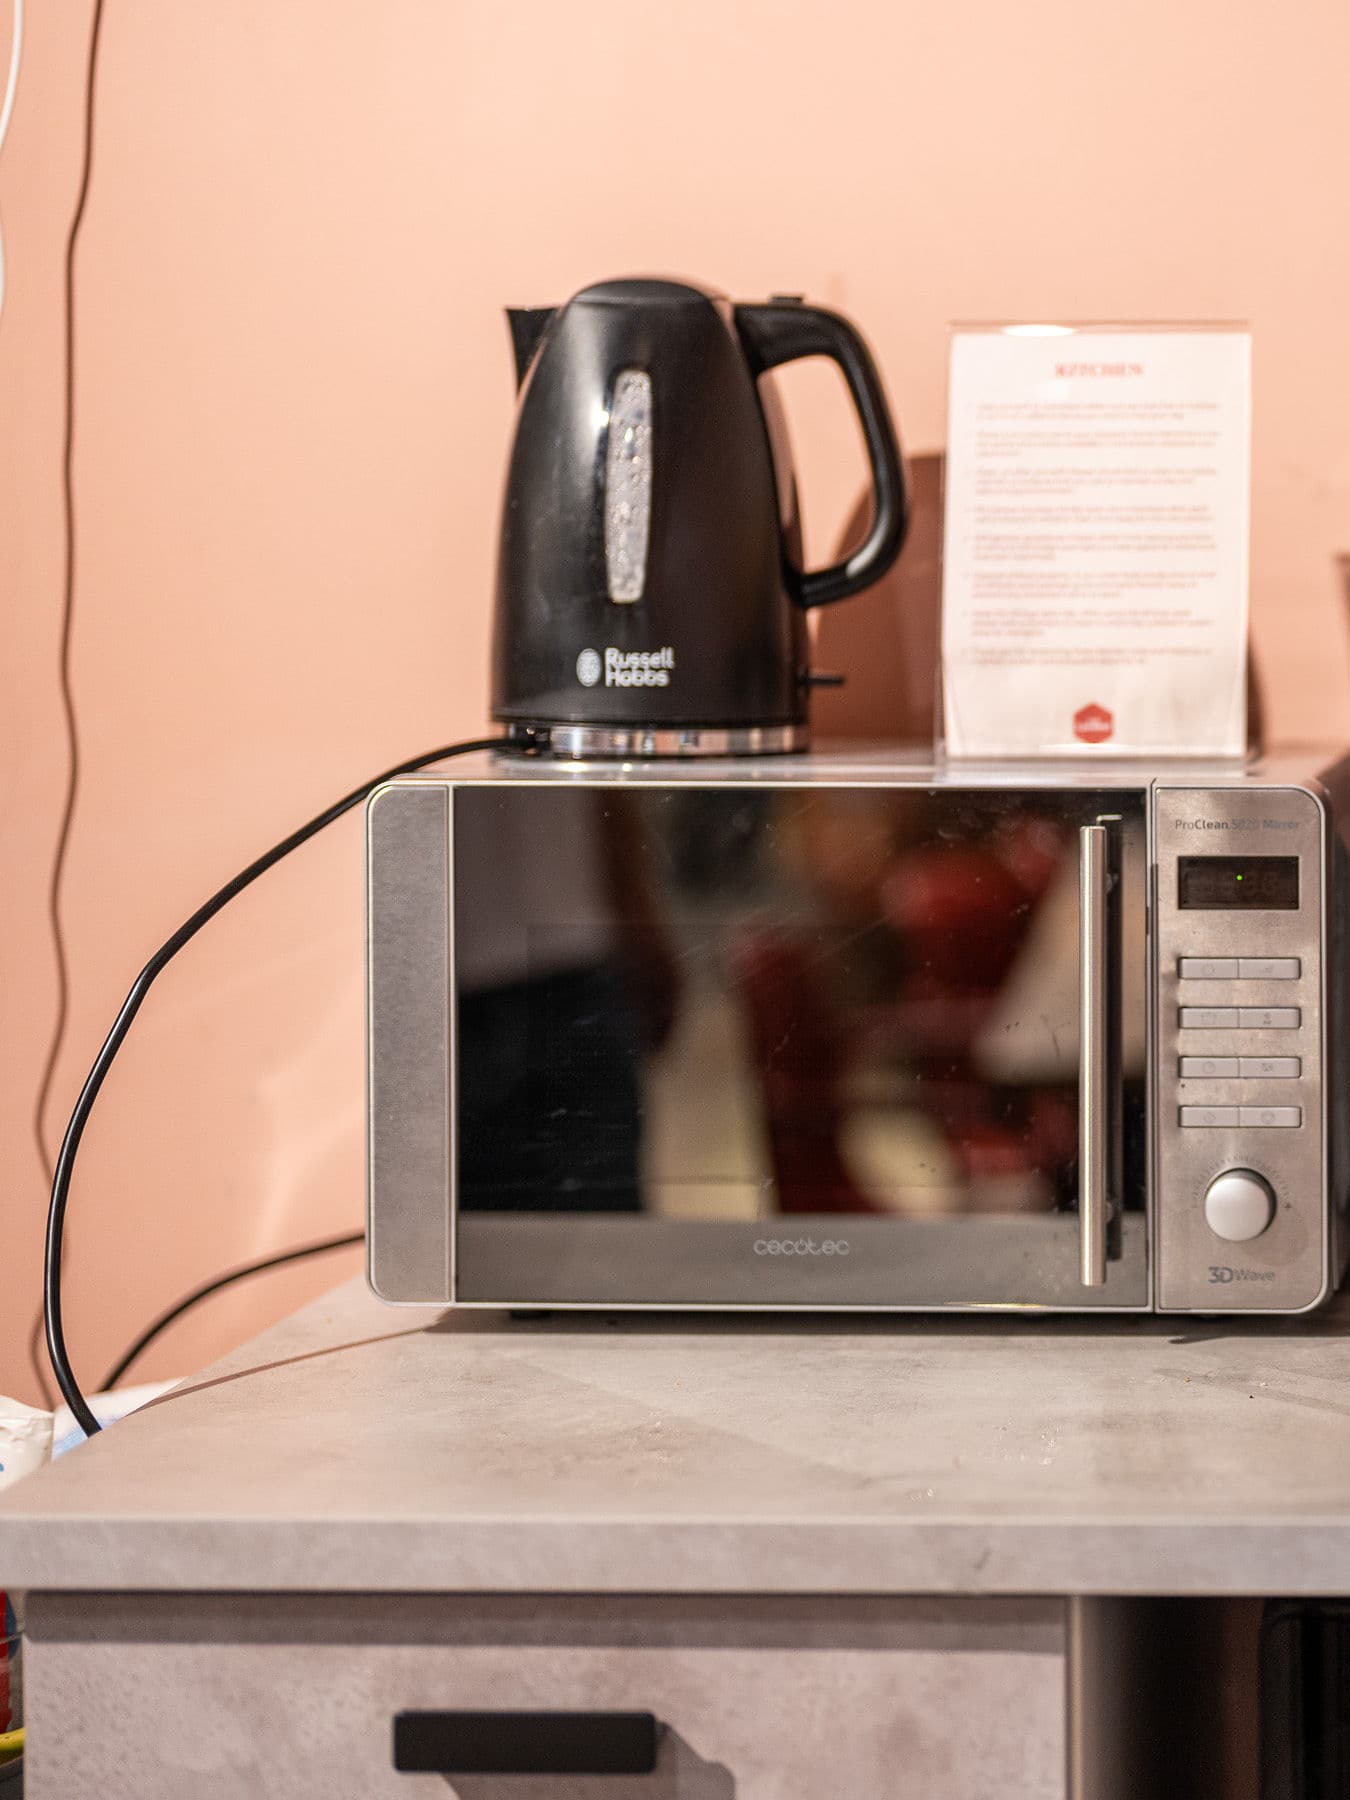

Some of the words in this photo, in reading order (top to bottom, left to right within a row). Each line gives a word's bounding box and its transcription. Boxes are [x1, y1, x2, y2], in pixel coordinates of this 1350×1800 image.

[605, 647, 674, 669] Russell
[605, 670, 669, 688] Hobbs
[1175, 819, 1229, 830] ProClean
[753, 1238, 850, 1255] cecotec
